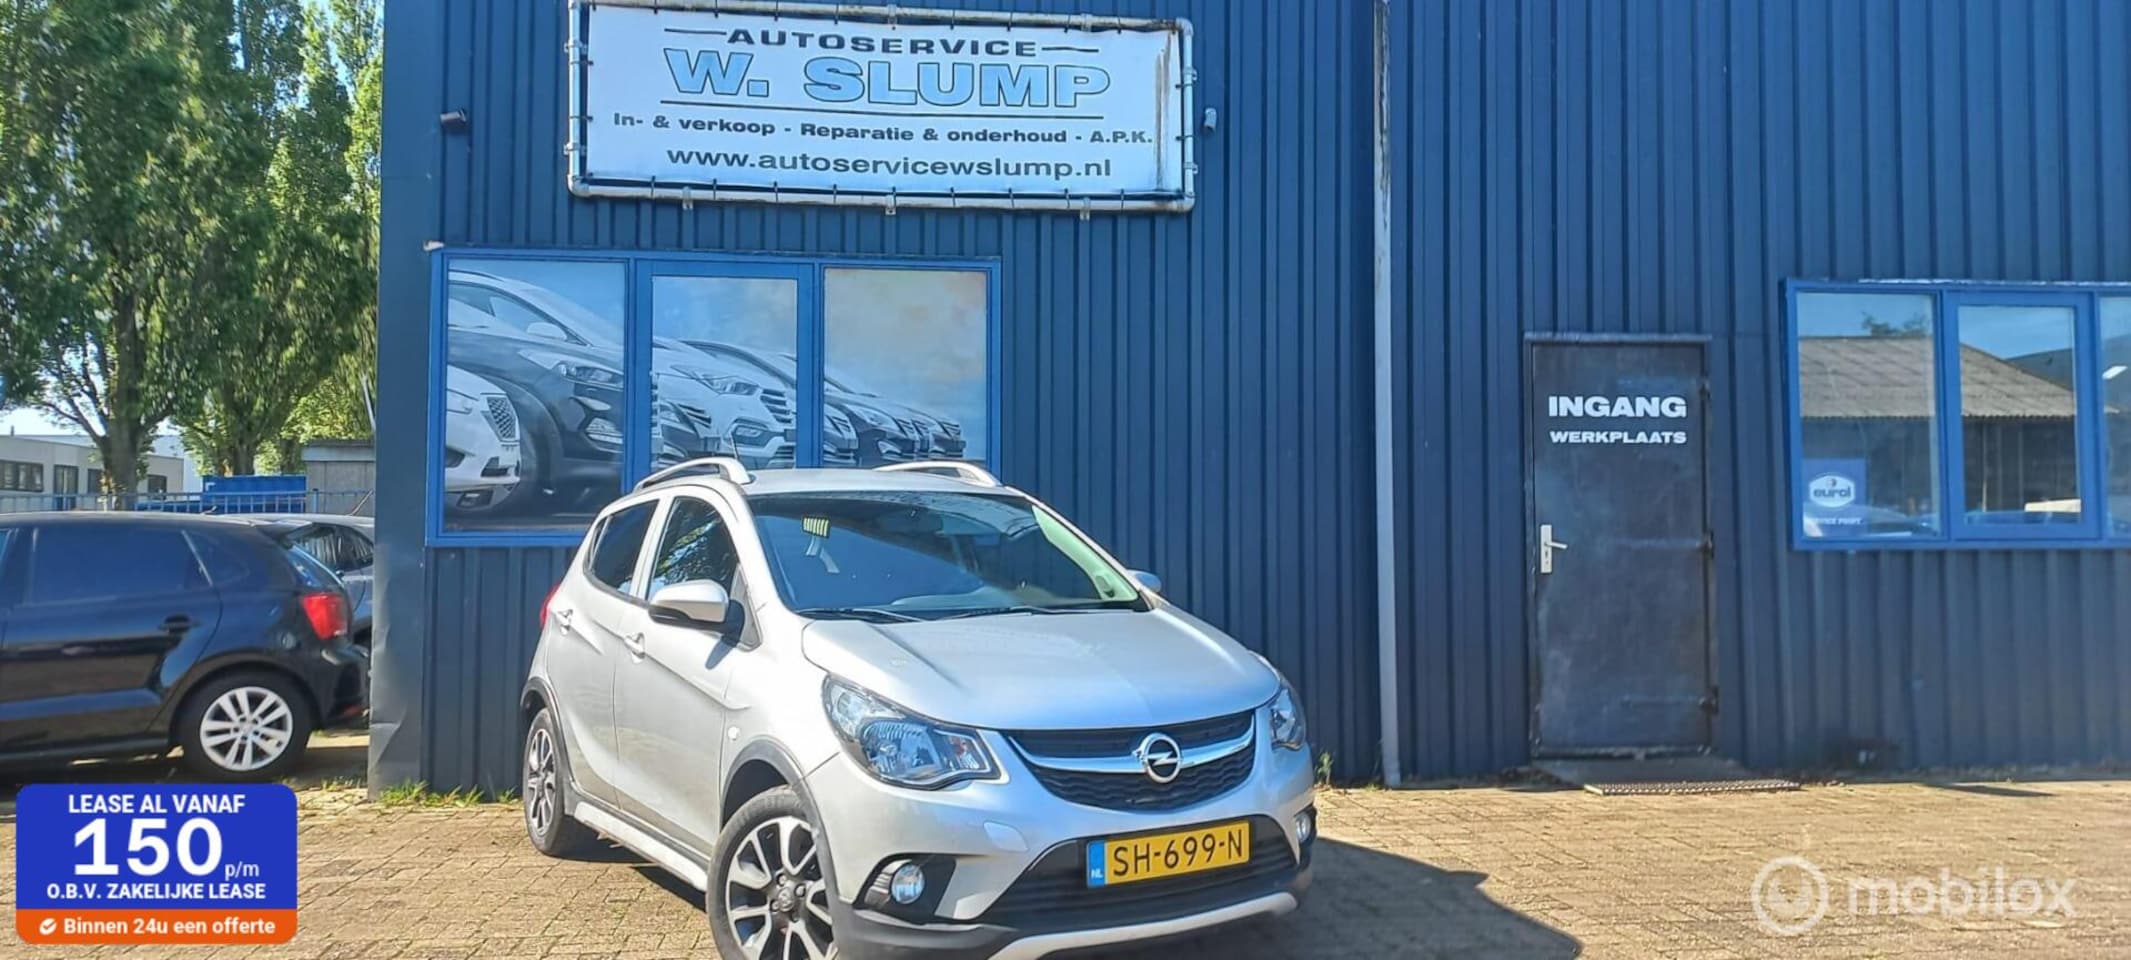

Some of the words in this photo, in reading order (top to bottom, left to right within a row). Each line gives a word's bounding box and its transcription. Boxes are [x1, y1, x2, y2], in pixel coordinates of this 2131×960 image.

[727, 28, 1037, 57] AUTOSERVICE
[663, 48, 770, 98] W.
[803, 56, 1111, 108] SLUMP
[614, 112, 643, 126] In-
[652, 115, 671, 129] &
[679, 117, 776, 137] verkoop
[800, 122, 914, 141] Reparatie
[922, 127, 939, 141] &
[947, 128, 1067, 143] onderhoud
[1090, 130, 1152, 144] A.P.K.
[667, 149, 1112, 181] www.autoservicewslump.nl
[1549, 396, 1687, 418] INGANG
[1550, 431, 1687, 444] WERKPLAATS
[1813, 486, 1852, 498] eurol
[1112, 829, 1243, 877] SH-699-N
[1091, 869, 1103, 879] NL
